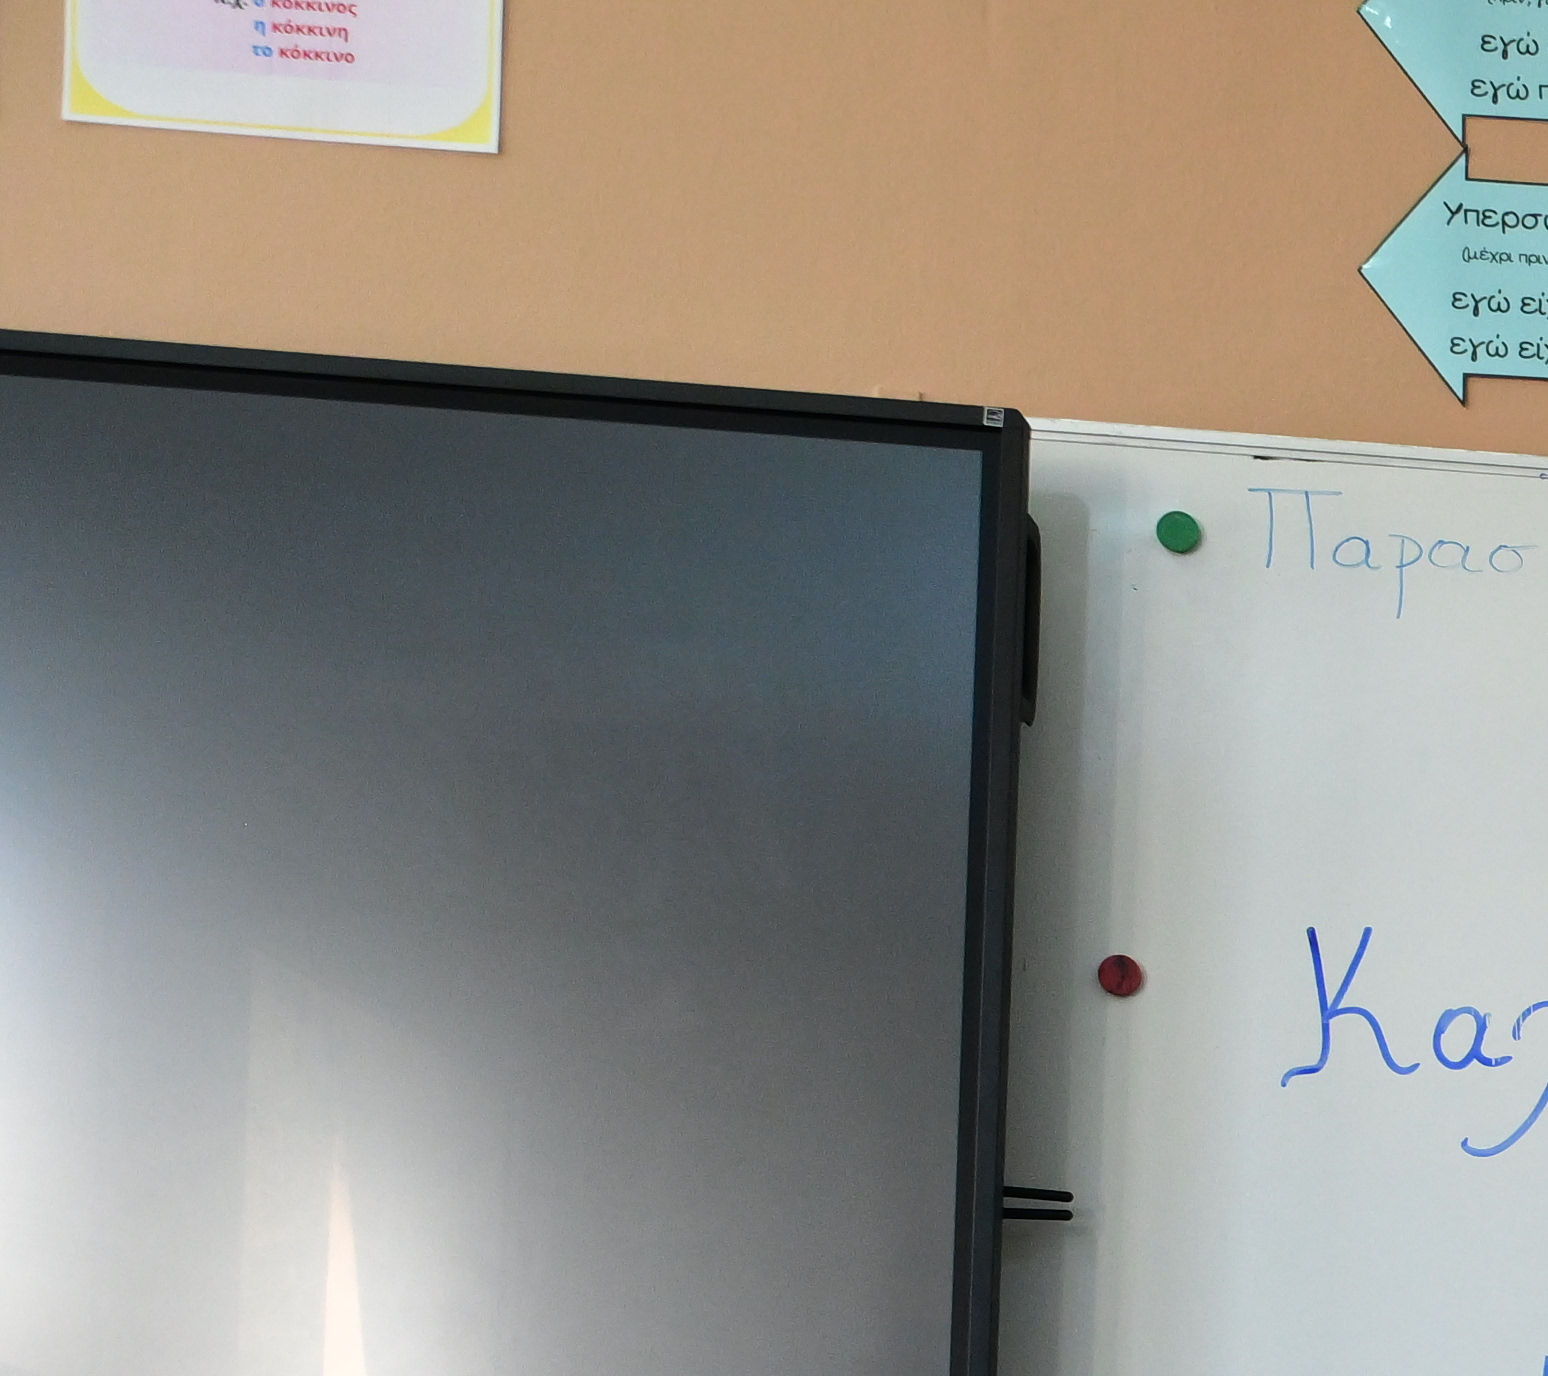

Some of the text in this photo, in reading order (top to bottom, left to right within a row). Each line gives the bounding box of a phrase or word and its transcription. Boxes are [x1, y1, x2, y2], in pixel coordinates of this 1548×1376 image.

[253, 19, 349, 43] η κόκκινη
[252, 44, 355, 64] το κόκκινο
[1480, 31, 1539, 60] εγώ
[1470, 76, 1529, 104] εγώ
[1462, 246, 1514, 265] (μέχρι
[1451, 288, 1511, 318] εγώ
[1449, 333, 1509, 362] εγώ
